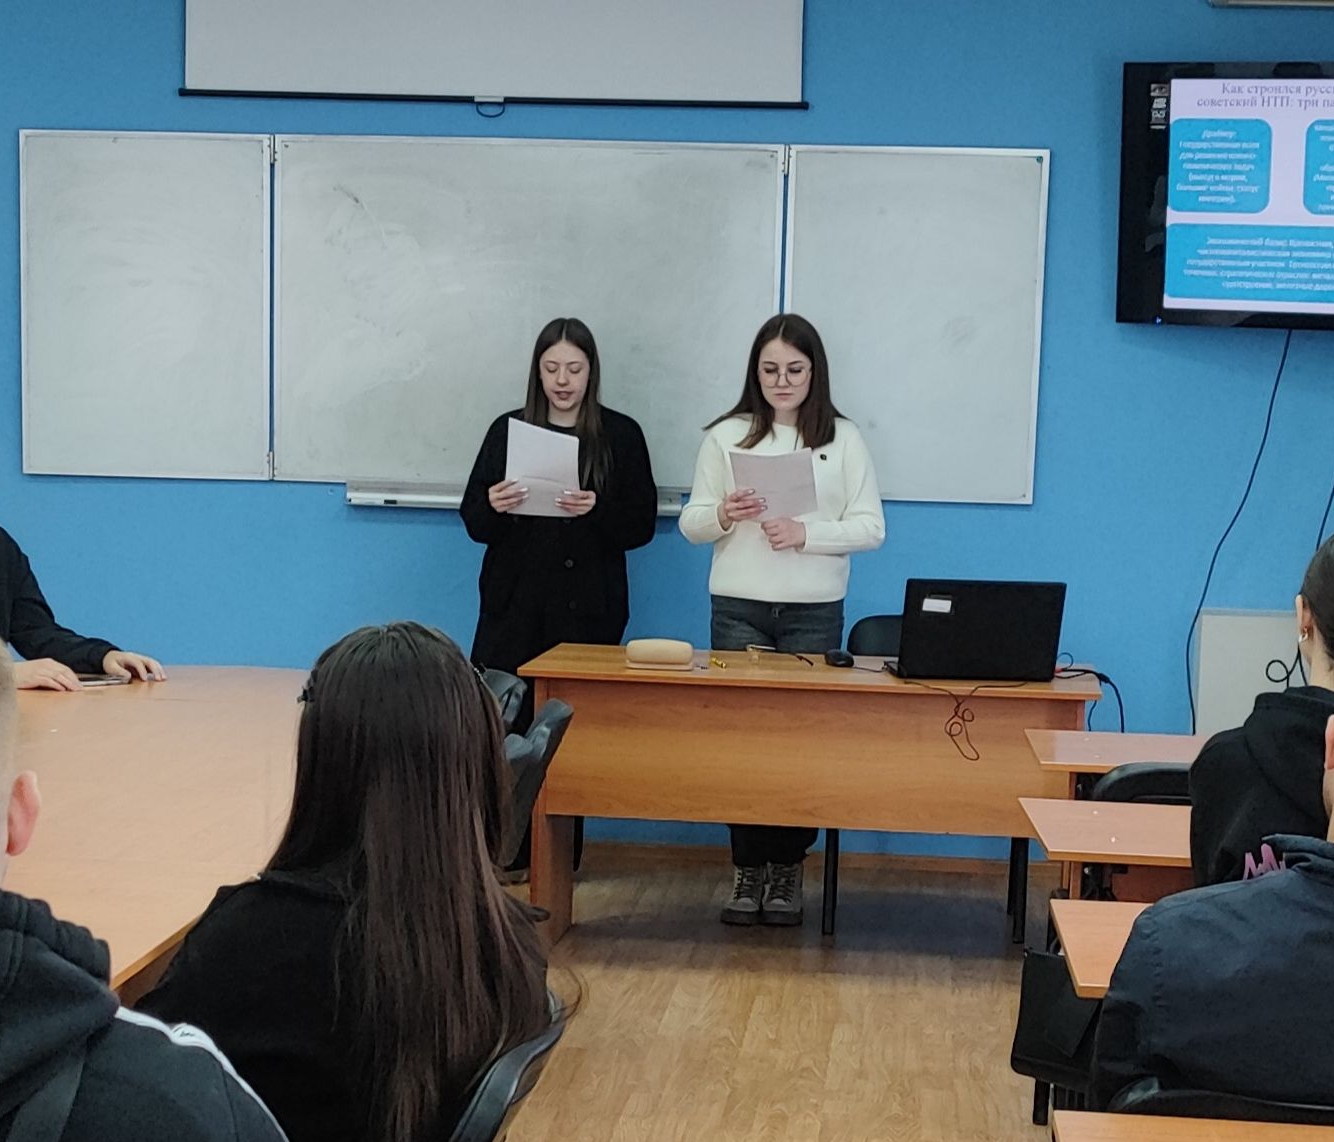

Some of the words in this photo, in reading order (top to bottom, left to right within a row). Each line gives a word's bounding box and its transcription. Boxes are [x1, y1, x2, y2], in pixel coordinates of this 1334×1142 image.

[1222, 82, 1245, 95] Как
[1247, 84, 1301, 96] строился
[1197, 96, 1257, 108] советский
[1260, 96, 1292, 108] НТП:
[1297, 98, 1318, 111] три
